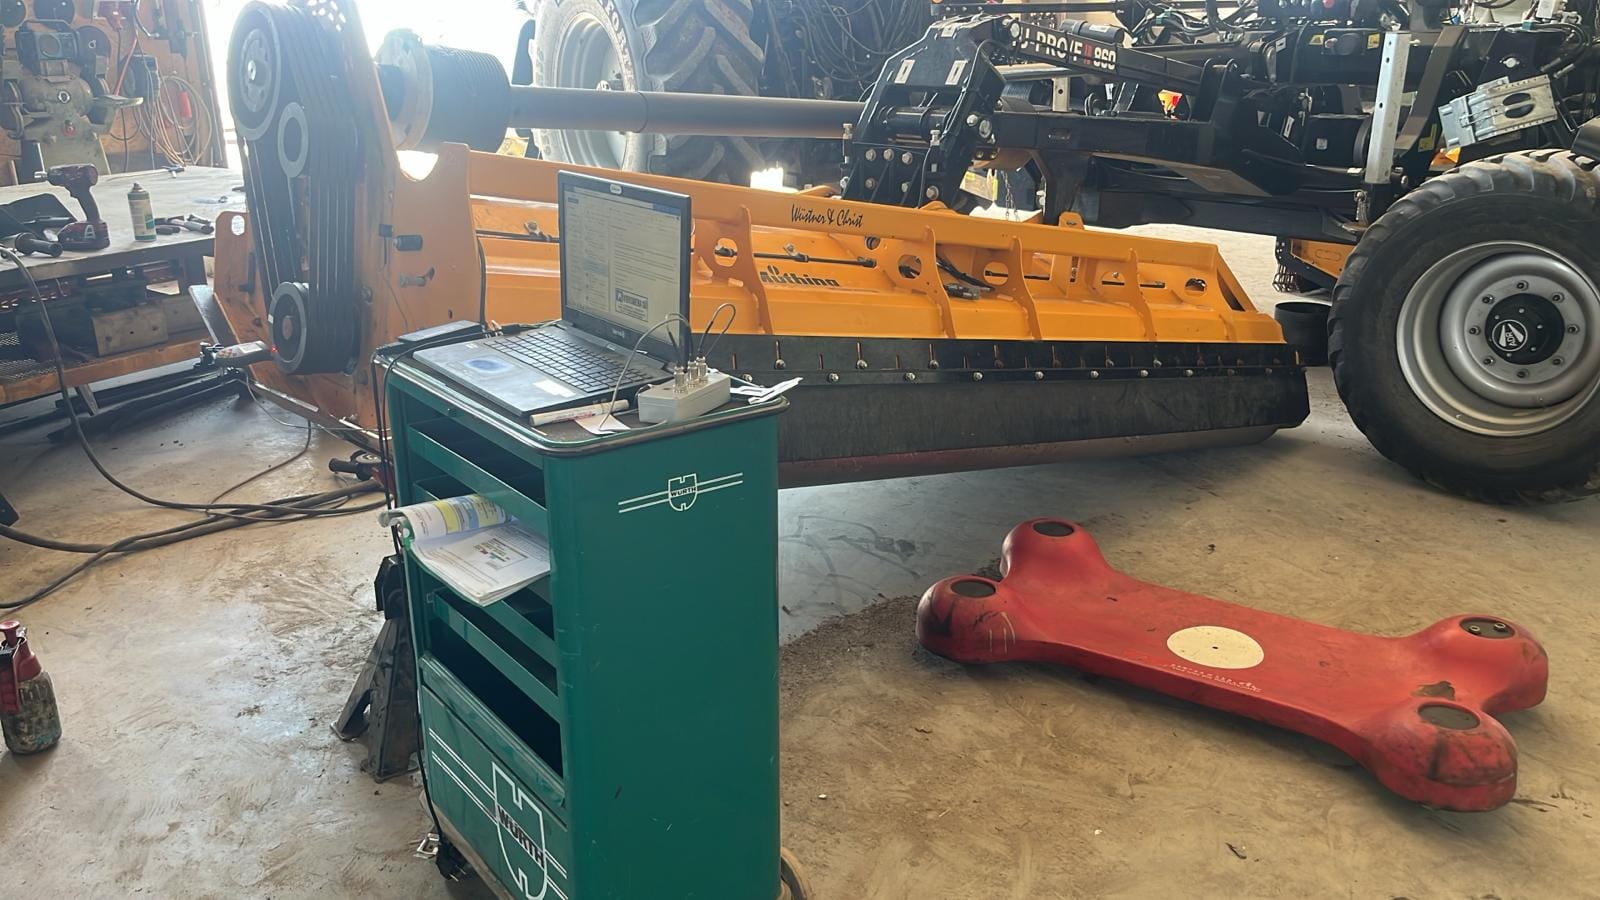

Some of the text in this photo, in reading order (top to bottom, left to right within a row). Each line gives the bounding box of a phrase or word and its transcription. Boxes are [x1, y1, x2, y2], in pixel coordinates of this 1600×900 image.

[1093, 46, 1117, 70] 860
[791, 203, 863, 228] Wüstner & Christ
[1505, 331, 1518, 347] ADR
